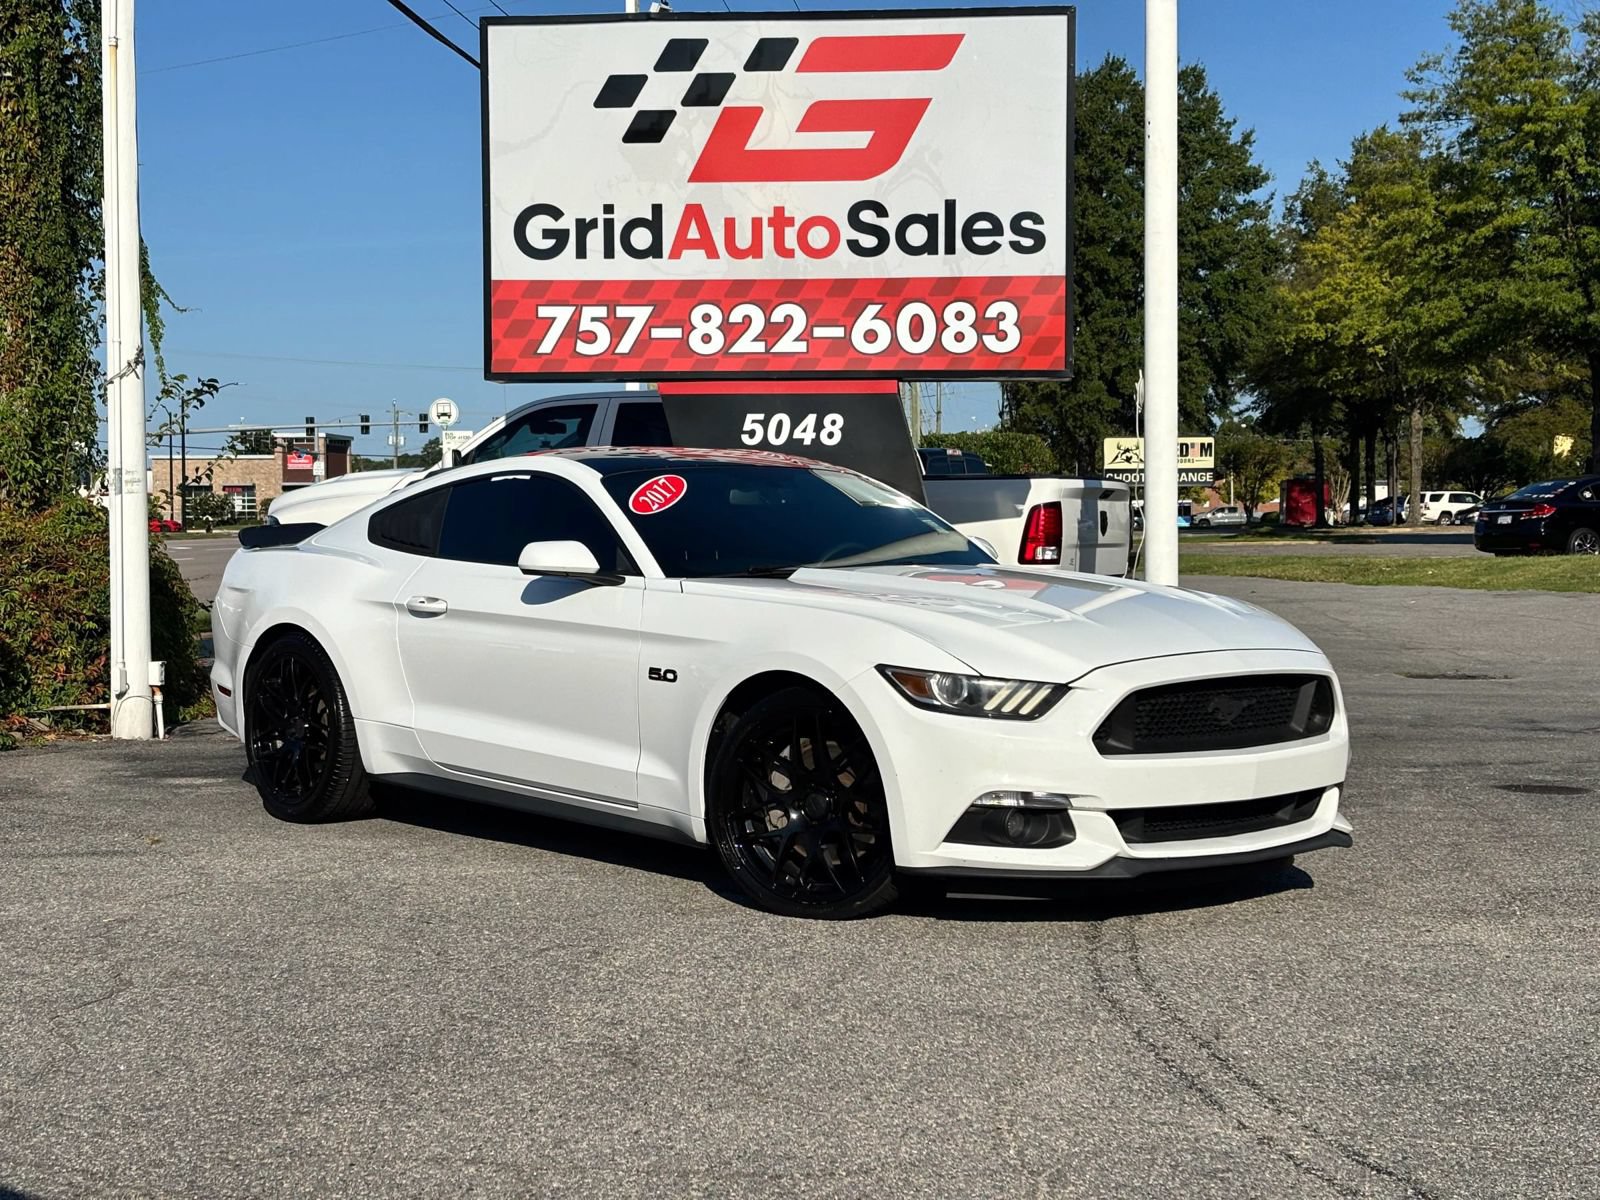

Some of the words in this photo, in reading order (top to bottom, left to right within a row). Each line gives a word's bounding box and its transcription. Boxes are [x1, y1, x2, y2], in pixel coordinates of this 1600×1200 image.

[513, 198, 1047, 261] GridAutoSales
[536, 301, 1021, 356] 757-822-6083
[740, 412, 844, 446] 5048
[1177, 472, 1213, 482] ANGE
[639, 478, 677, 510] 2017
[648, 666, 678, 683] 5.0
